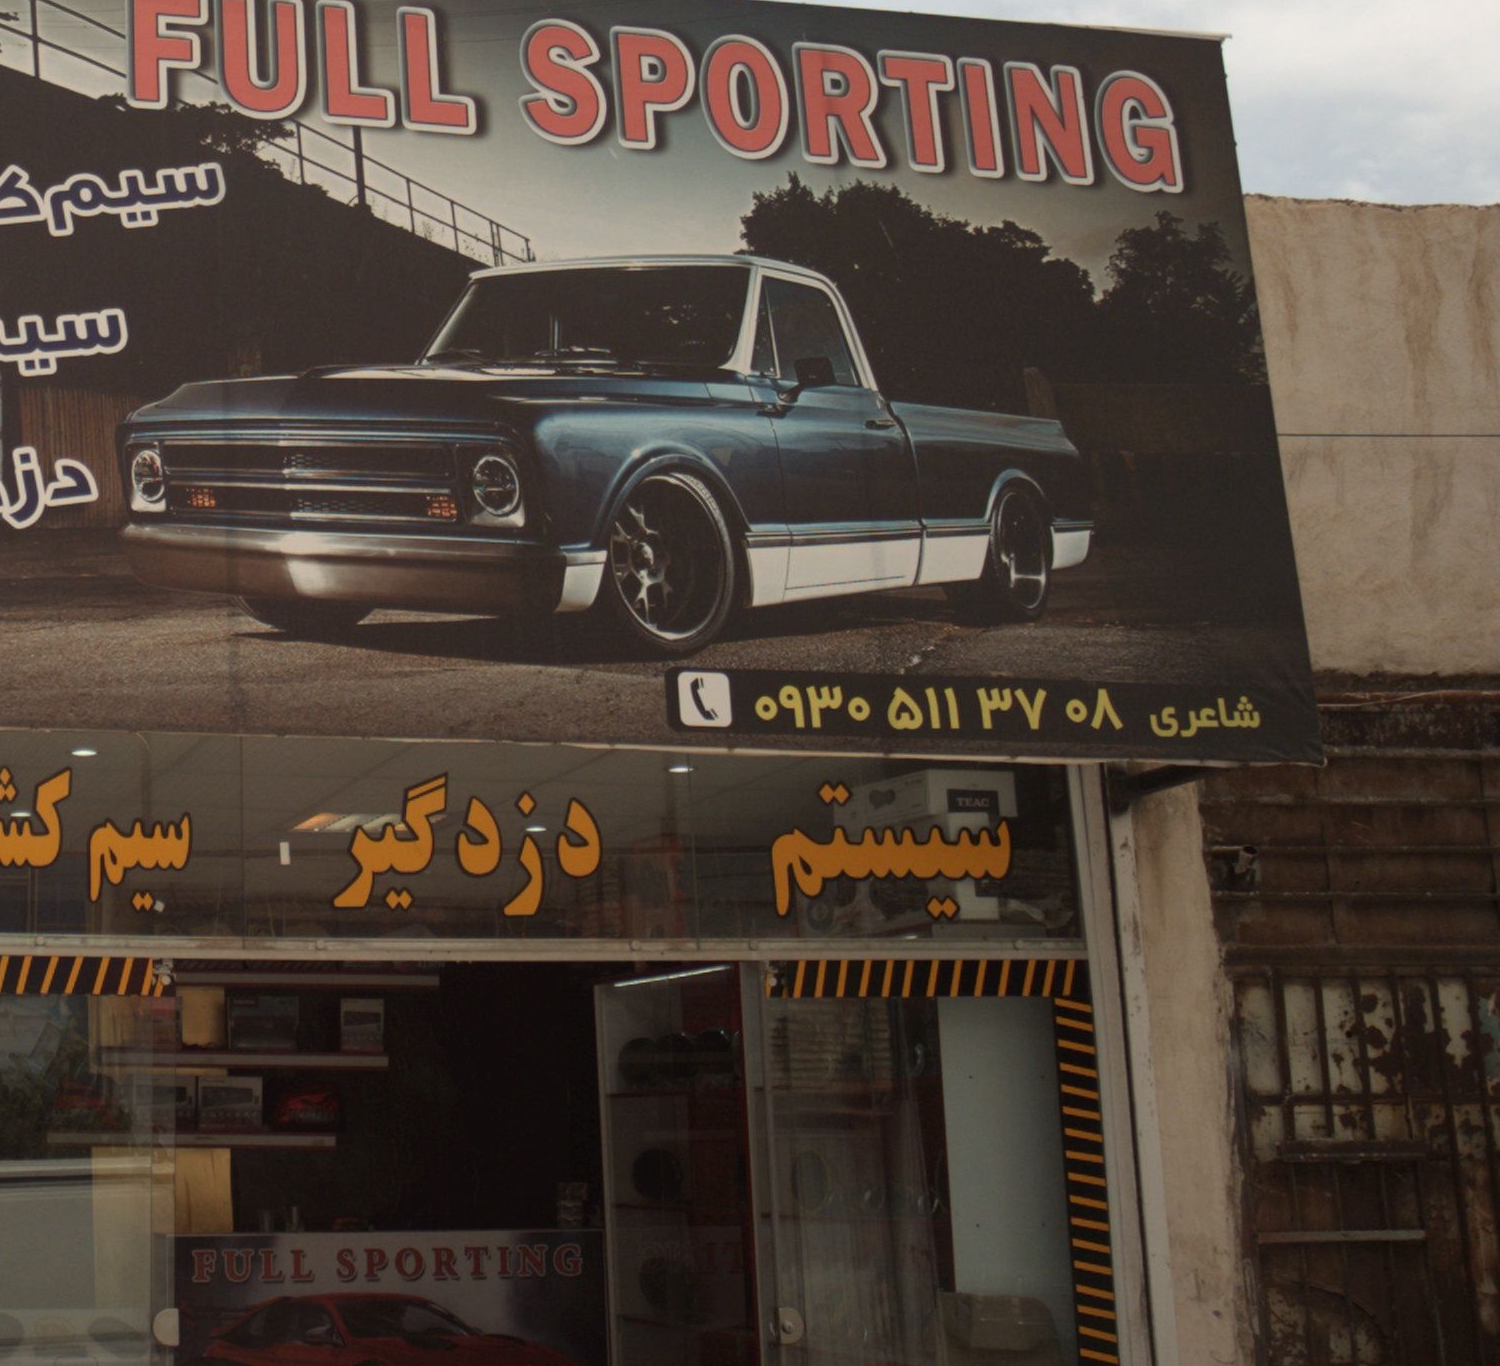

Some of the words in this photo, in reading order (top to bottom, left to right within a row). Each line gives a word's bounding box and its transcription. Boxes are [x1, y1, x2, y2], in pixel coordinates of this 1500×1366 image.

[520, 19, 1184, 193] SPORTING
[754, 684, 871, 729] ۰۹۳۰
[887, 686, 961, 730] ۵۱۱
[976, 687, 1048, 731] ۳۷
[1065, 687, 1124, 731] ۰۸
[1149, 695, 1262, 738] شاعری
[956, 797, 990, 808] TEAC
[89, 812, 192, 912] سیم
[771, 780, 1013, 921] سیستم
[192, 1248, 315, 1283] FULL
[336, 1243, 584, 1282] SPORTING
